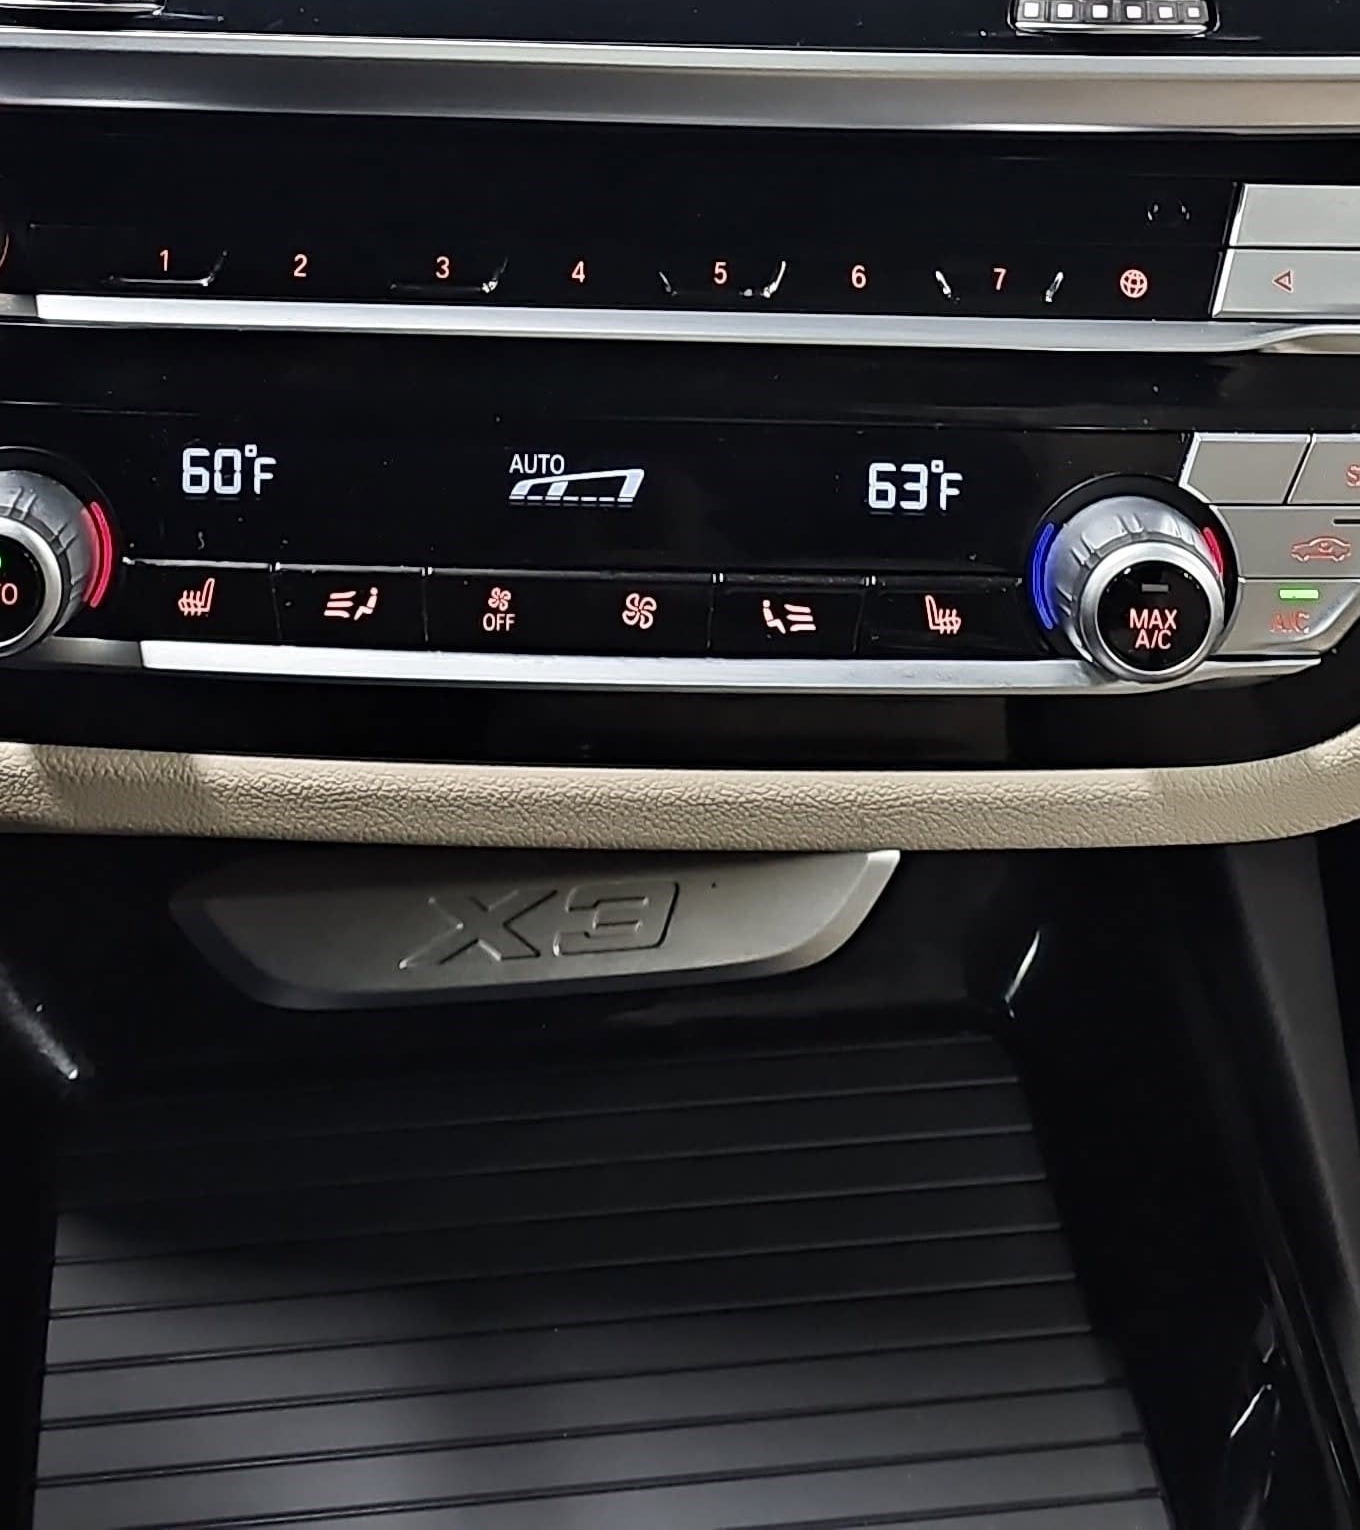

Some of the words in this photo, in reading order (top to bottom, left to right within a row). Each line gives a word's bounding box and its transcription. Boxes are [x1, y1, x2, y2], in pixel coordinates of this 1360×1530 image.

[159, 249, 169, 271] 1
[292, 253, 307, 278] 2
[435, 256, 450, 280] 3
[571, 260, 586, 284] 4
[713, 261, 728, 285] 5
[851, 265, 866, 290] 6
[993, 268, 1006, 291] 7
[509, 453, 566, 476] AUTO
[482, 612, 516, 632] OFF
[1129, 607, 1177, 631] MAX
[1134, 628, 1172, 650] A/C
[397, 879, 680, 972] X3
